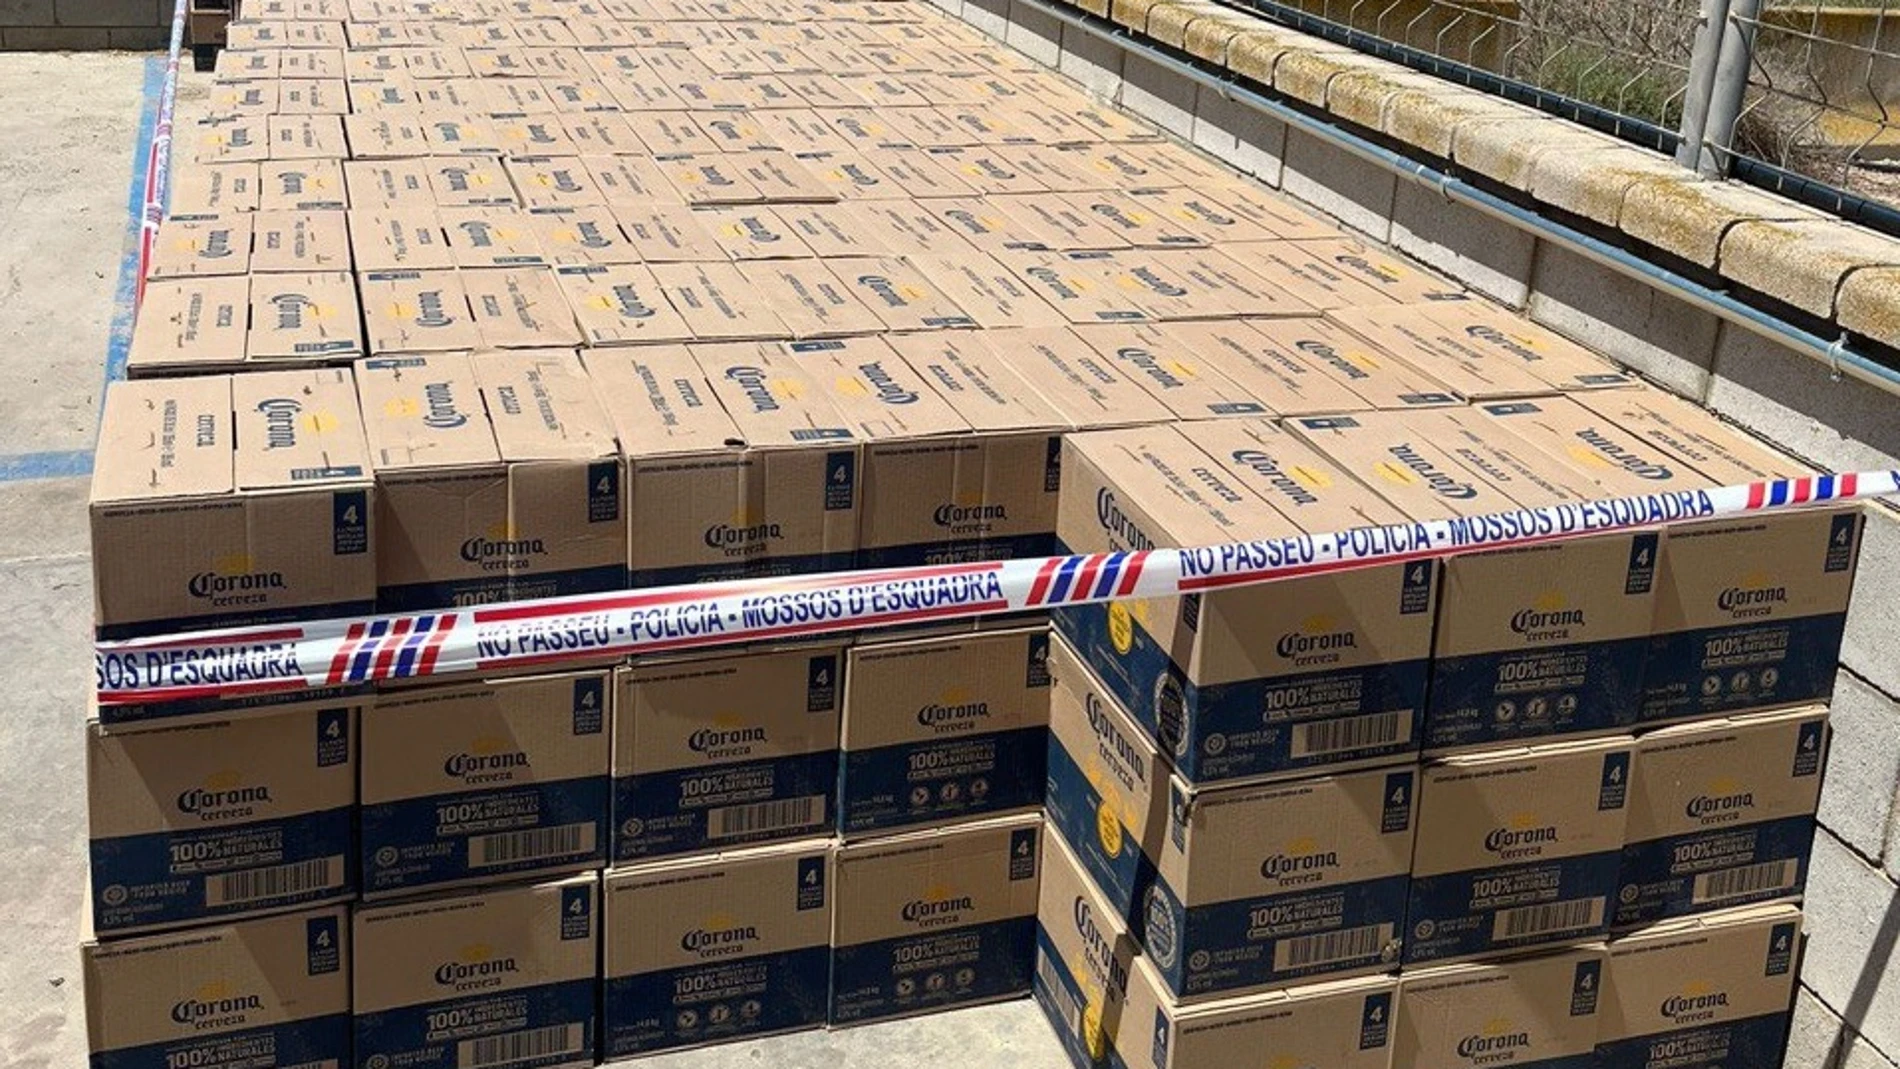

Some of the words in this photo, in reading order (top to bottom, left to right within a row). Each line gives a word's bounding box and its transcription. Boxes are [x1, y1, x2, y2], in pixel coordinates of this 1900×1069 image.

[1117, 348, 1183, 390] Corona
[725, 366, 779, 413] Corona
[1576, 427, 1673, 481] Corona
[834, 465, 846, 482] 4
[1232, 450, 1318, 506] Corona
[1388, 443, 1478, 500] Corona
[597, 476, 610, 493] 4
[1192, 468, 1242, 503] cerveza
[344, 506, 358, 524] 4
[934, 504, 1007, 528] Corona
[705, 524, 784, 549] Corona
[951, 523, 991, 534] cerveza
[1178, 547, 1214, 577] NO
[1222, 534, 1314, 572] PASSEU
[1336, 523, 1430, 558] POLICIA
[1448, 507, 1553, 546] MOSSOS
[1556, 490, 1715, 532] D'ESQUADRA
[1836, 528, 1847, 545] 4
[460, 536, 548, 564] Corona
[724, 542, 766, 556] cerveza
[1637, 549, 1648, 566] 4
[482, 559, 529, 571] cerveza
[1410, 567, 1424, 584] 4
[189, 571, 286, 599] Corona
[213, 593, 267, 606] cerveza
[1718, 586, 1787, 611] Corona
[478, 624, 511, 658] NO
[518, 615, 609, 654] PASSEU
[631, 603, 724, 640] POLICIA
[742, 589, 842, 628] MOSSOS
[848, 572, 1003, 615] D'ESQUADRA
[1511, 609, 1585, 633] Corona
[1733, 606, 1771, 619] cerveza
[1527, 629, 1569, 642] cerveza
[1035, 646, 1047, 662] 4
[1277, 631, 1358, 660] Corona
[1705, 638, 1744, 657] 100%
[147, 643, 303, 687] D'ESQUADRA
[1296, 653, 1339, 667] cerveza
[816, 669, 828, 685] 4
[1499, 662, 1539, 681] 100%
[582, 691, 594, 708] 4
[1265, 686, 1310, 709] 100%
[918, 702, 990, 727] Corona
[326, 720, 339, 737] 4
[934, 721, 975, 733] cerveza
[689, 727, 767, 752] Corona
[1086, 693, 1146, 787] Corona
[1804, 734, 1815, 750] 4
[708, 746, 751, 759] cerveza
[909, 752, 949, 769] 100%
[445, 752, 530, 776] Corona
[466, 772, 512, 785] cerveza
[1610, 765, 1620, 783] 4
[681, 776, 723, 796] 100%
[1392, 786, 1404, 803] 4
[178, 786, 272, 814] Corona
[1686, 792, 1754, 818] Corona
[202, 807, 253, 820] cerveza
[437, 804, 483, 823] 100%
[1701, 811, 1740, 825] cerveza
[1017, 840, 1028, 855] 4
[1485, 826, 1559, 851] Corona
[170, 843, 221, 861] 100%
[1501, 846, 1541, 859] cerveza
[1674, 843, 1713, 861] 100%
[1261, 852, 1339, 879] Corona
[806, 869, 817, 884] 4
[1279, 873, 1323, 887] cerveza
[1472, 880, 1513, 898] 100%
[570, 898, 582, 915] 4
[903, 896, 974, 921] Corona
[918, 914, 960, 927] cerveza
[1250, 906, 1294, 926] 100%
[317, 930, 330, 947] 4
[682, 926, 760, 952] Corona
[1075, 896, 1127, 999] Corona
[1775, 935, 1787, 951] 4
[700, 944, 743, 958] cerveza
[894, 945, 935, 962] 100%
[435, 957, 519, 985] Corona
[456, 977, 502, 991] cerveza
[676, 975, 718, 994] 100%
[1581, 972, 1593, 989] 4
[172, 994, 264, 1023] Corona
[1661, 990, 1729, 1017] Corona
[195, 1014, 245, 1029] cerveza
[427, 1010, 474, 1030] 100%
[1370, 1005, 1383, 1022] 4
[1675, 1010, 1714, 1024] cerveza
[1457, 1031, 1529, 1057] Corona
[1649, 1041, 1687, 1059] 100%
[166, 1050, 218, 1069] 100%
[1473, 1051, 1514, 1065] cerveza
